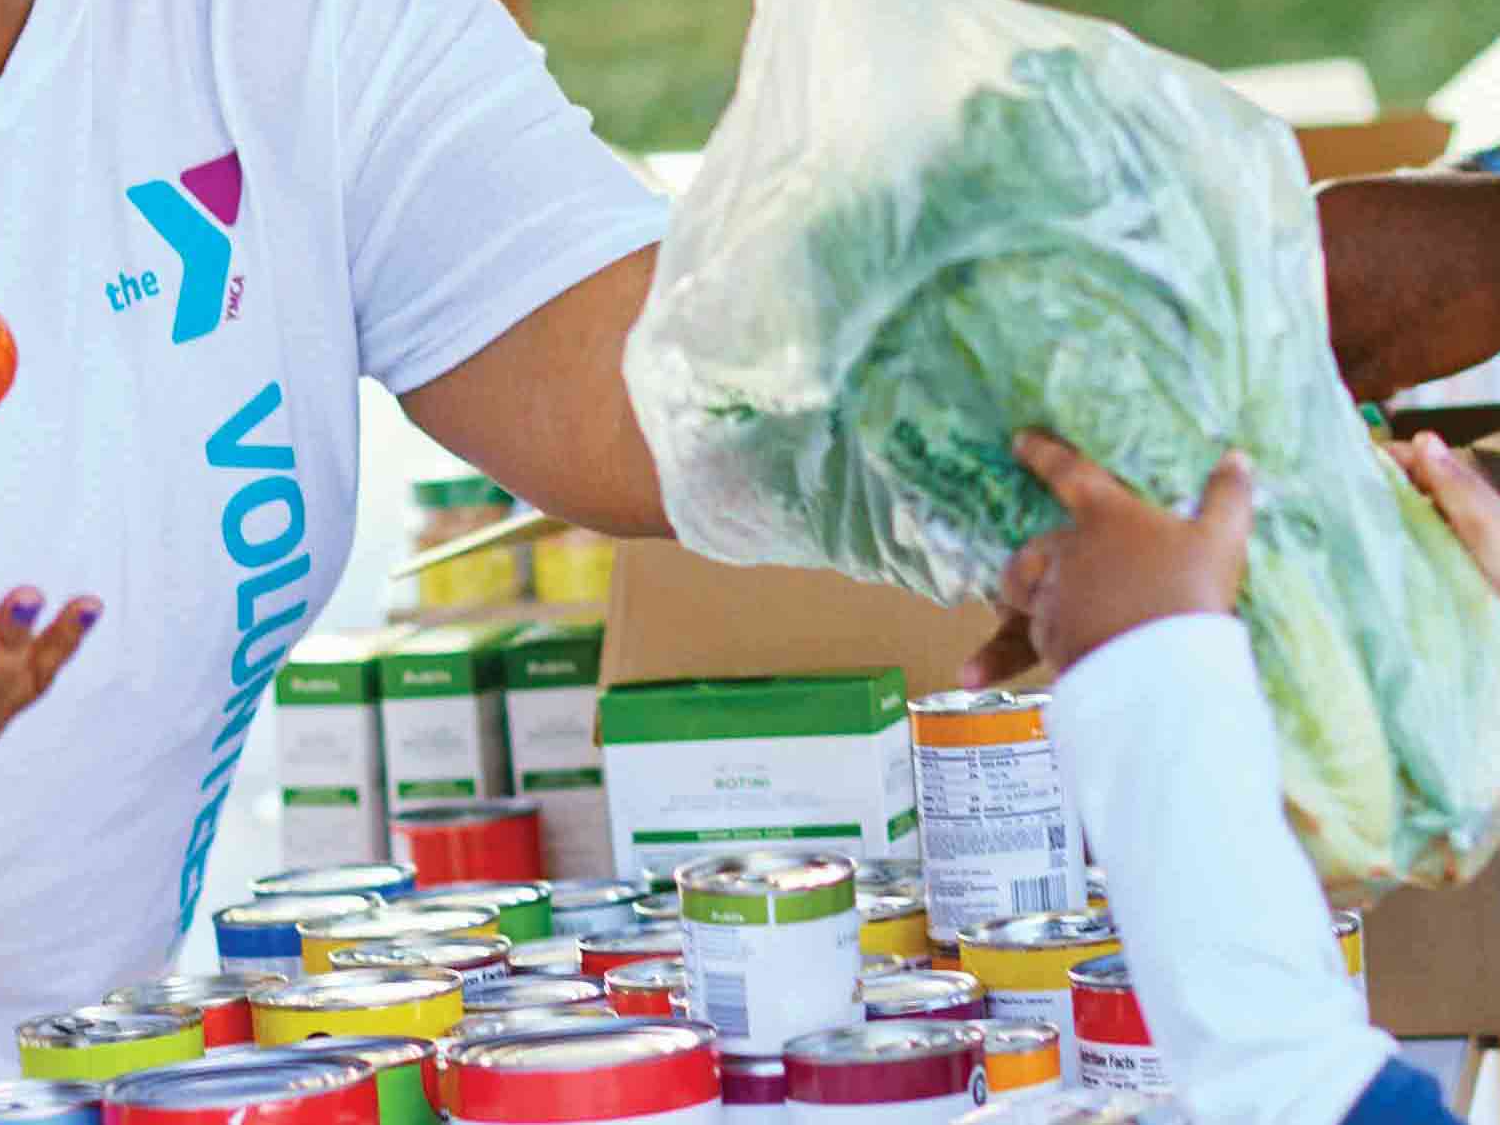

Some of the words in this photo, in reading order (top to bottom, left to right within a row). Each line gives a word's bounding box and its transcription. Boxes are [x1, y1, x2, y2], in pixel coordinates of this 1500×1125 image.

[125, 149, 244, 346] Y
[105, 266, 161, 313] the
[224, 273, 247, 324] YMCA
[179, 380, 312, 935] VOLUNTEE
[1108, 1051, 1136, 1070] Facts
